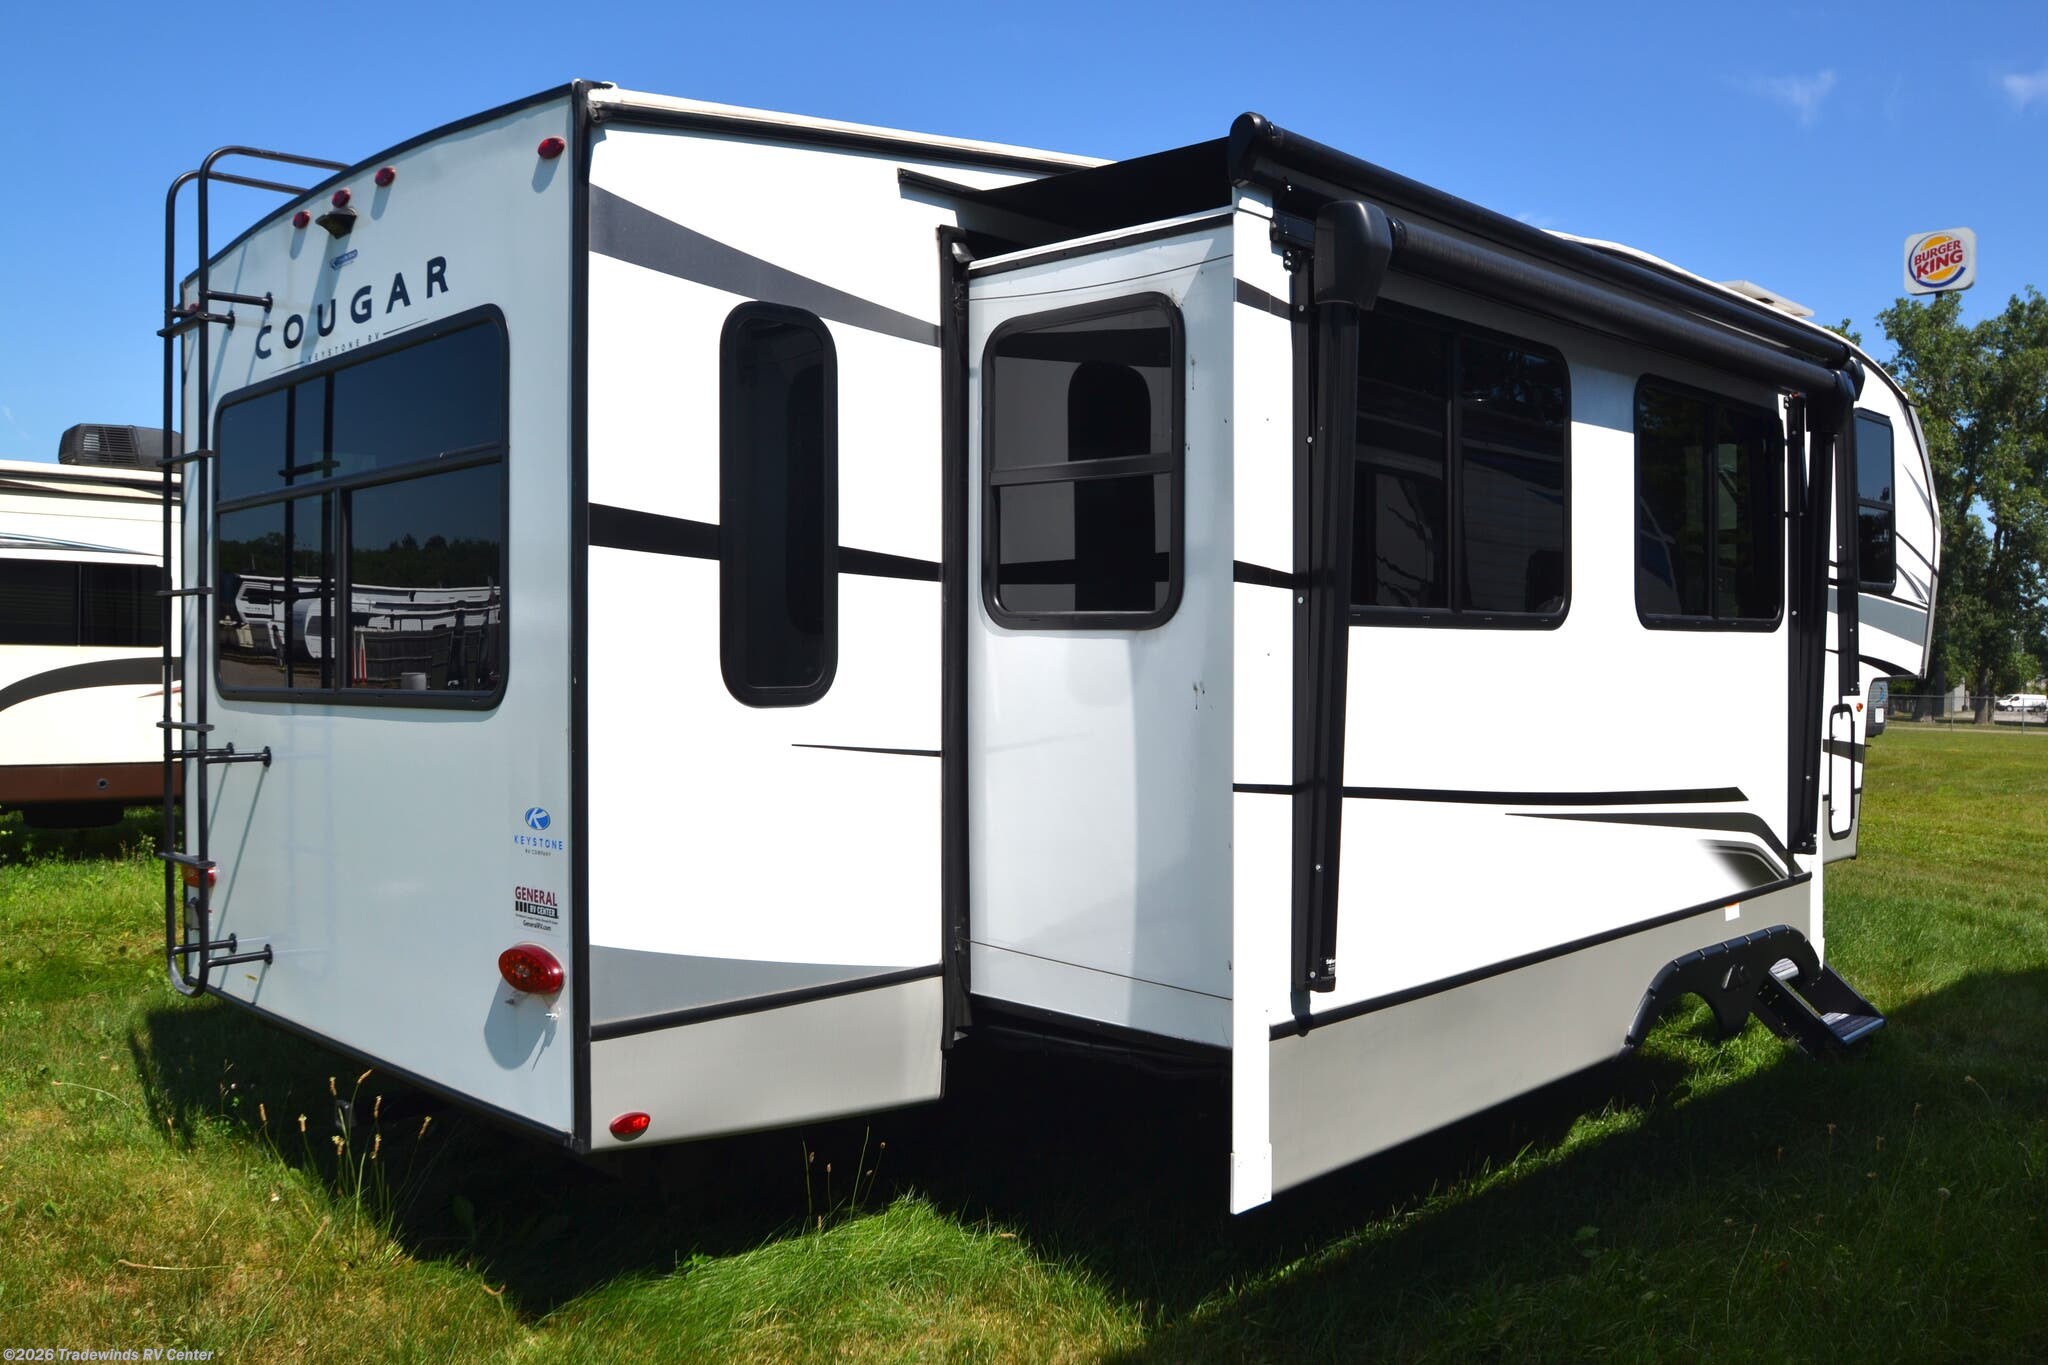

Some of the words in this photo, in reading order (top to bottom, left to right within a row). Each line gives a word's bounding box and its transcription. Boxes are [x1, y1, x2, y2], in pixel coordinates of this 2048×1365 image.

[1914, 240, 1961, 266] BURGER
[1916, 249, 1963, 279] KING
[255, 256, 449, 360] COUGAR
[513, 834, 563, 850] KEYSTONE
[515, 886, 557, 907] GENERAL
[529, 904, 537, 914] RV
[537, 905, 556, 917] CENTER
[523, 919, 552, 931] GeneralRV.com
